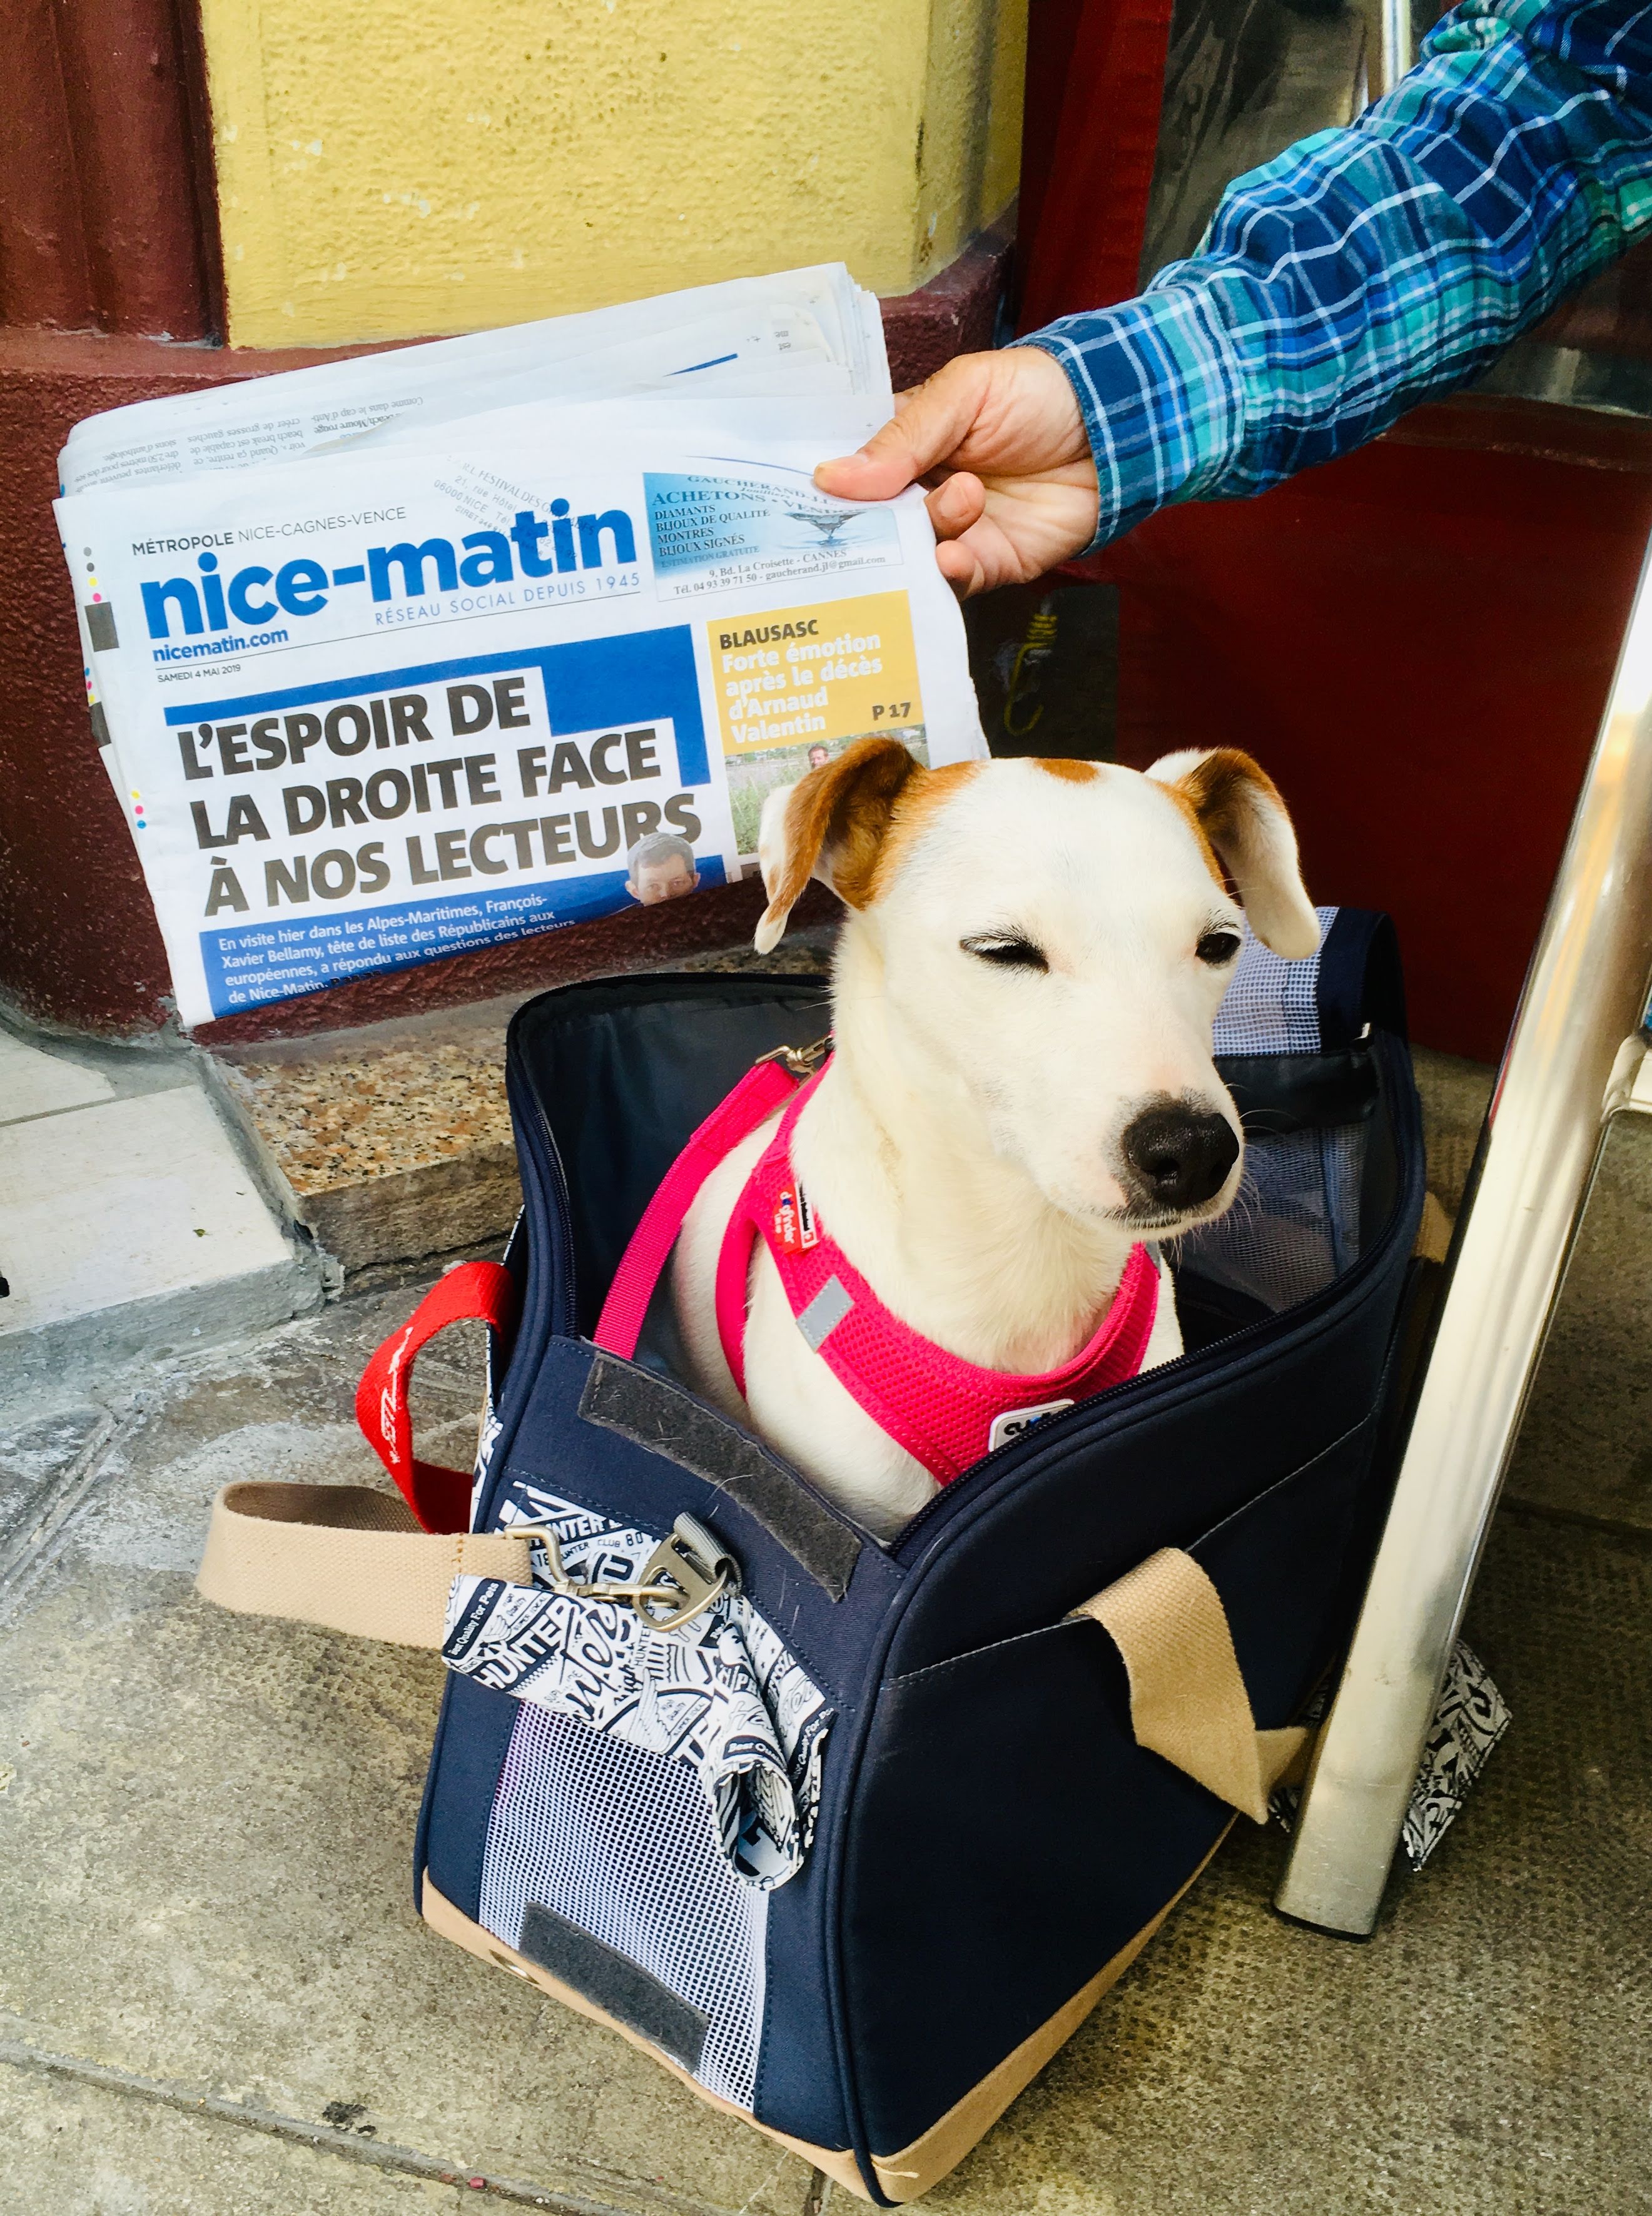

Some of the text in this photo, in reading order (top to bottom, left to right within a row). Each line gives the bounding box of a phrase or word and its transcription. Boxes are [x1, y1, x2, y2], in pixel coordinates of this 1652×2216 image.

[343, 408, 356, 417] cap
[359, 407, 368, 415] le
[369, 402, 389, 413] dans
[392, 397, 424, 407] Comme
[188, 418, 301, 443] créer de grosses gauches
[251, 432, 276, 444] break
[278, 430, 304, 441] beach
[314, 423, 338, 434] rouge
[155, 439, 177, 448] sions
[203, 441, 236, 454] capable
[237, 437, 251, 447] est
[250, 445, 279, 458] Quand
[193, 457, 204, 465] ce
[237, 450, 248, 460] ça
[433, 478, 464, 501] 06000
[463, 495, 489, 514] NICE
[472, 485, 489, 498] rue
[492, 493, 517, 512] Hôtel
[478, 470, 523, 499] FESTIVAL
[522, 491, 542, 508] DES
[652, 490, 766, 505] ACHETONS
[654, 504, 716, 520] DIAMANTS
[656, 508, 771, 533] BIJOUX DE QUALITÉ
[132, 506, 407, 555] MÉTROPOLE NICE-CAGNES-VENCE
[657, 527, 714, 545] MONTRES
[659, 532, 746, 558] BIJOUX SIGNÉS
[661, 545, 761, 569] ESTIMATION GRATUITE
[139, 498, 637, 639] nice-matin
[719, 566, 736, 577] Bd.
[737, 564, 751, 574] La
[752, 557, 795, 570] Croisette
[802, 549, 848, 564] CANNES
[673, 584, 692, 595] Tél.
[693, 582, 705, 592] 04
[706, 580, 719, 590] 93
[719, 578, 732, 588] 39
[732, 575, 744, 585] 71
[746, 572, 758, 583] 50
[375, 572, 641, 625] RÉSEAU SOCIAL DEPUIS 1945
[152, 629, 290, 662] nicematin.com
[719, 619, 820, 650] BLAUSASC
[722, 632, 882, 674] Forte émotion
[157, 664, 241, 683] SAMEDI 4 MAI 2019
[725, 656, 883, 702] après le décès
[728, 686, 829, 721] d'Arnaud
[871, 701, 912, 722] P 17
[177, 675, 532, 781] L'ESPOIR DE
[731, 712, 826, 745] Valentin
[190, 727, 663, 851] LA DROITE FACE
[202, 792, 703, 918] À NOS LECTEURS
[219, 893, 549, 951] En visite hier dans les Alpes-Maritimes, François-
[221, 911, 556, 969] Xavier Bellamy, tête de liste des Républicains aux
[225, 919, 576, 986] européennes, a répondu aux questions des lecteurs
[228, 989, 248, 1004] de
[248, 979, 329, 1001] Nice-Matin.
[456, 1618, 480, 1646] Quality
[469, 1603, 487, 1621] For
[479, 1582, 500, 1606] Pets
